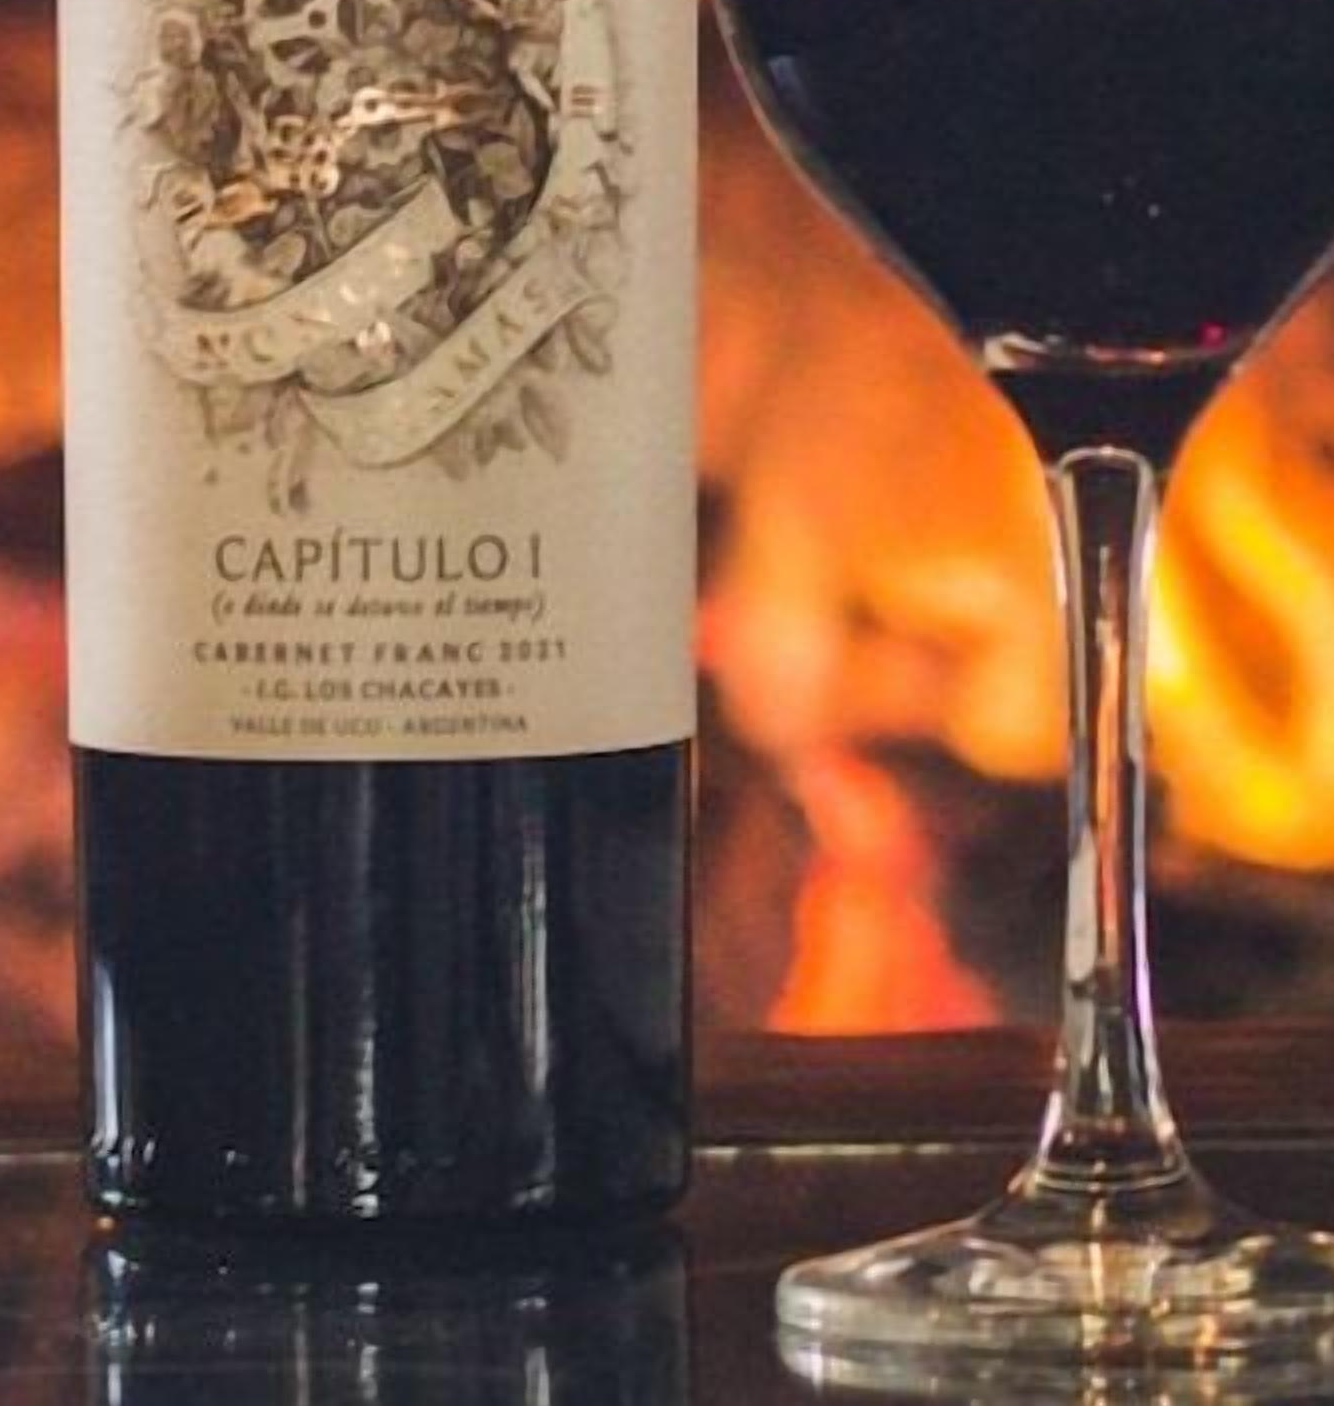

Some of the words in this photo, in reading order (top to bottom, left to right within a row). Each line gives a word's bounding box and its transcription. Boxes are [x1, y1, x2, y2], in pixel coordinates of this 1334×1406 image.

[214, 525, 509, 582] CAPÍTULO
[529, 531, 541, 580] I
[193, 641, 356, 666] CABERNET
[373, 641, 485, 665] FRANC
[305, 677, 353, 702] LOS
[403, 712, 529, 736] ARGENTINA
